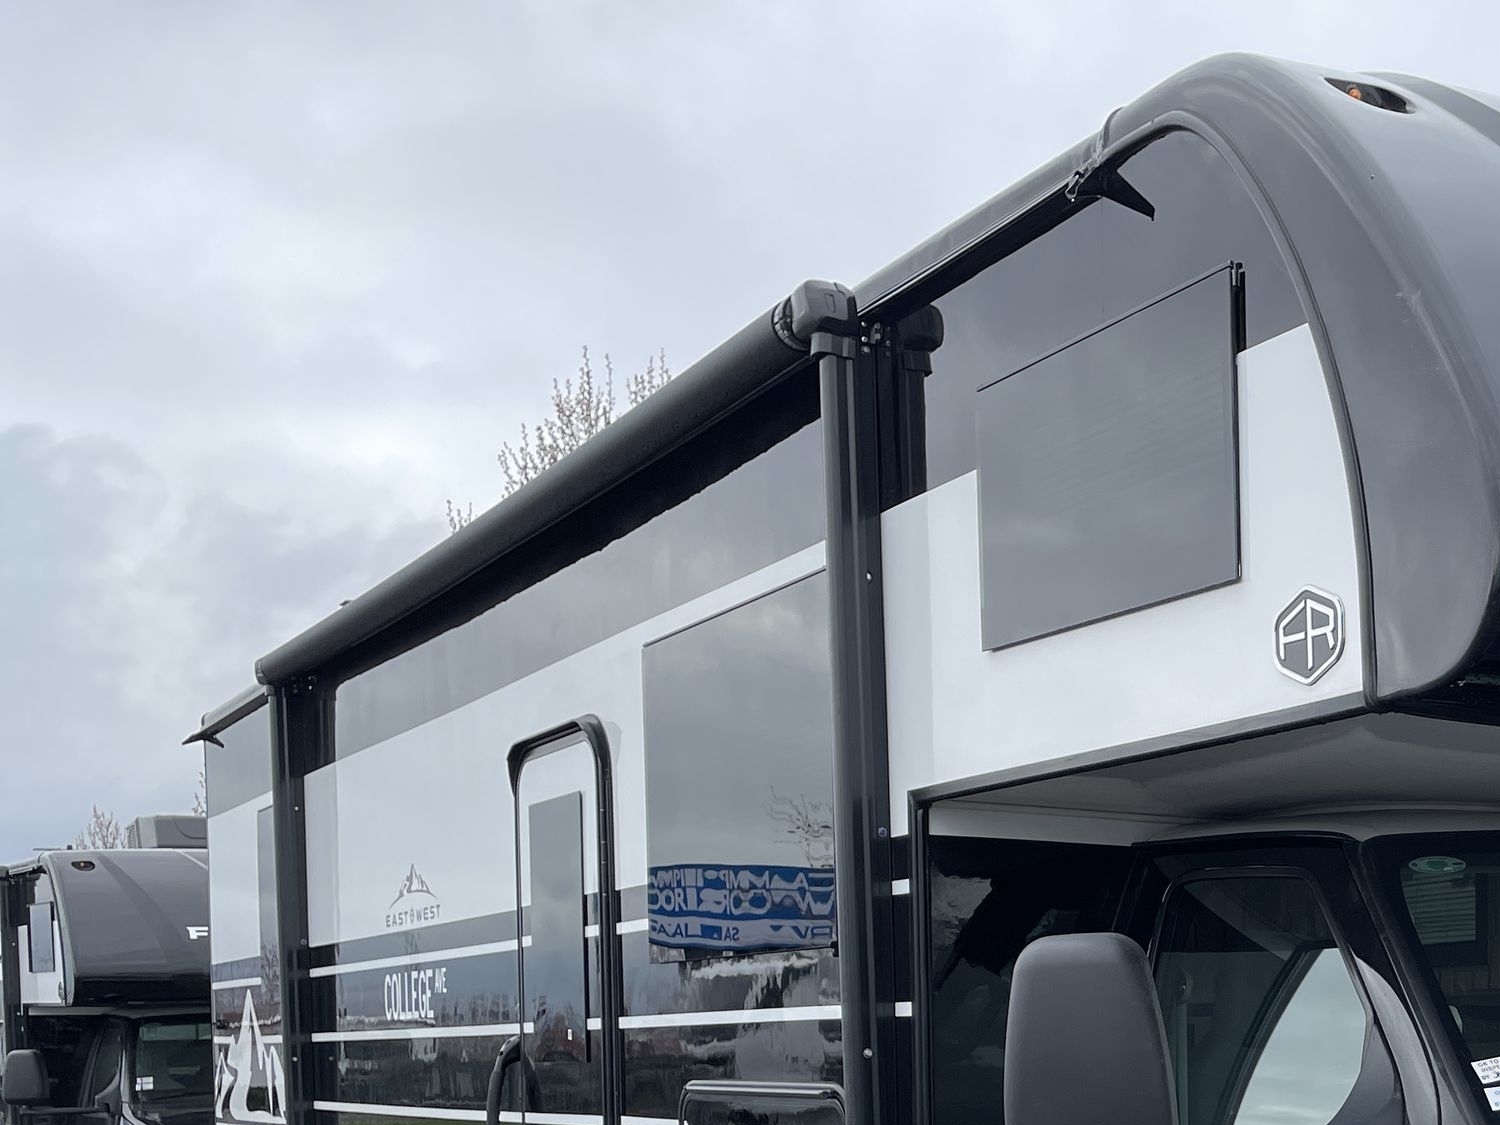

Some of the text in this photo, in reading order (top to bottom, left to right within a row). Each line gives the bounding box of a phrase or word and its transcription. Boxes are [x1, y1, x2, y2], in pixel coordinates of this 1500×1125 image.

[385, 904, 441, 928] EAST WEST
[384, 967, 447, 1021] COLLEGE AVE
